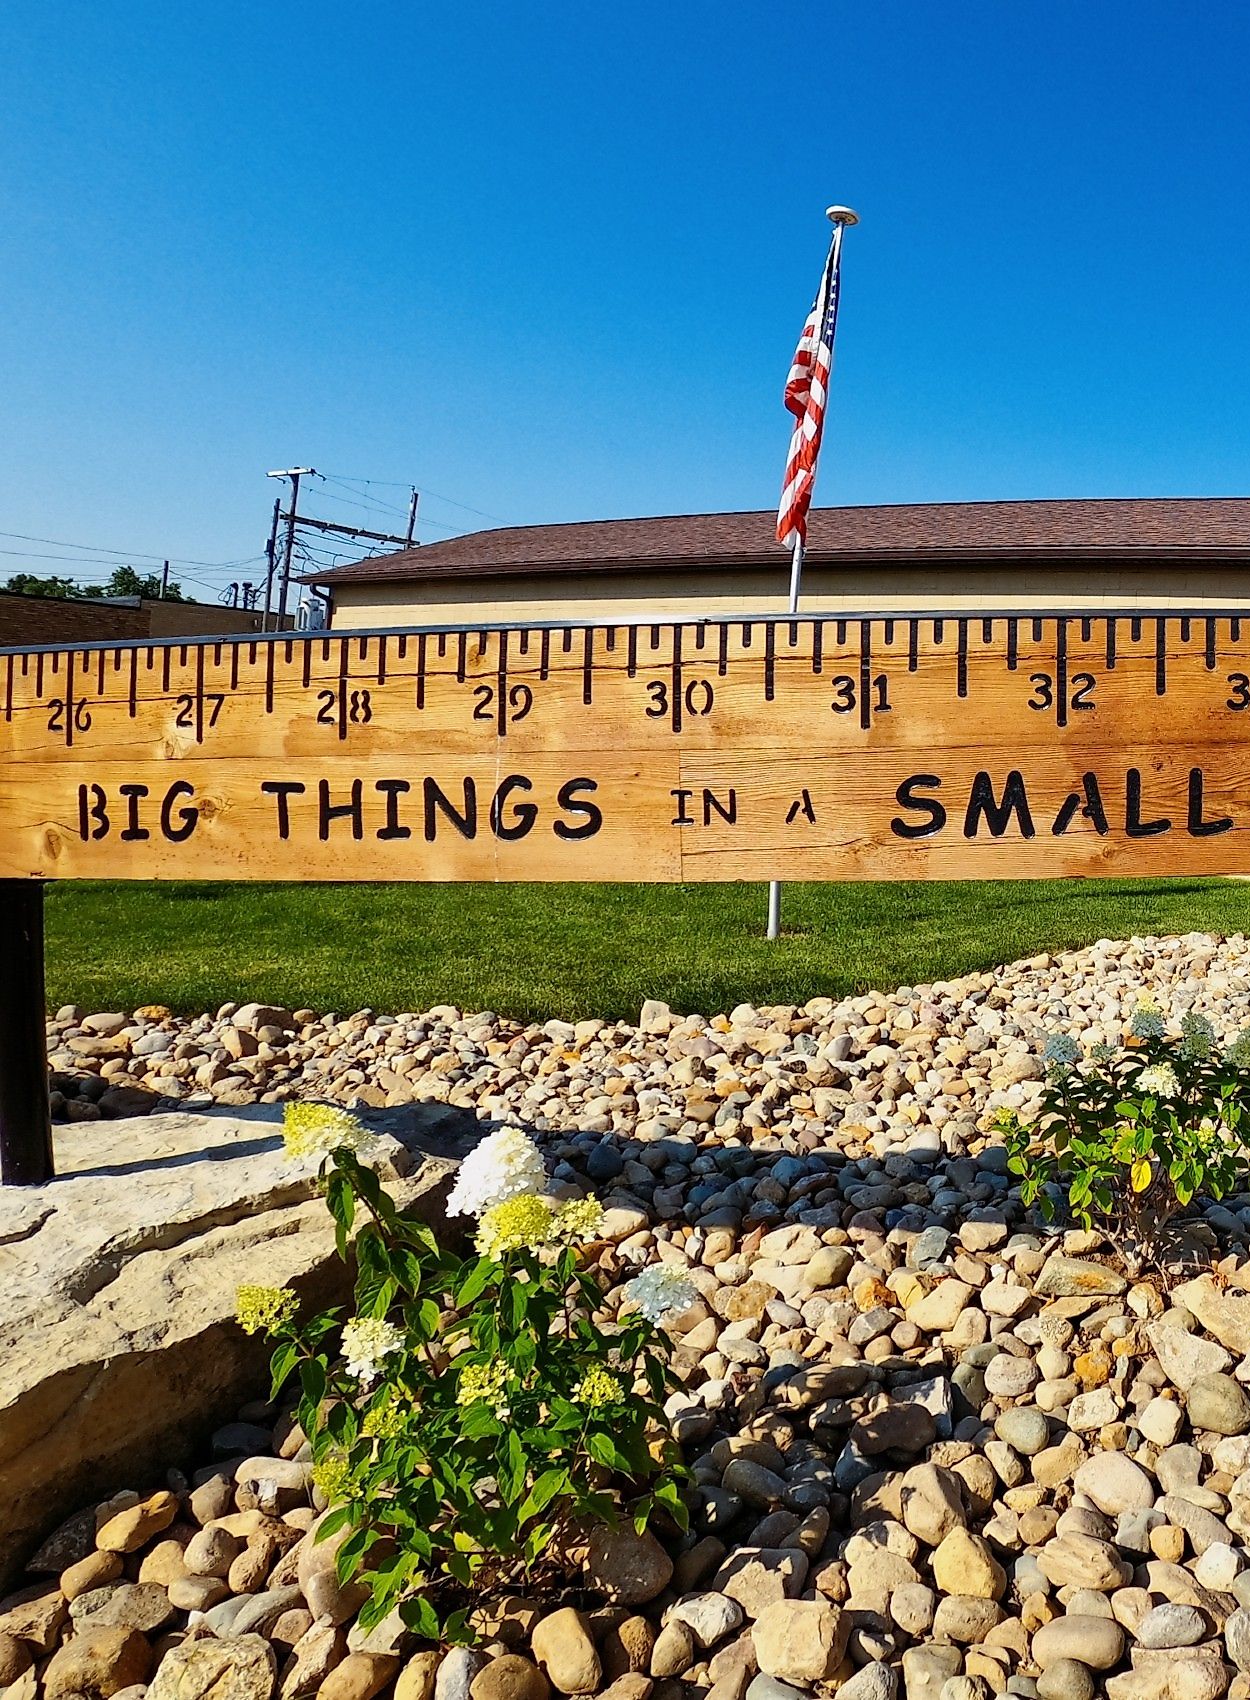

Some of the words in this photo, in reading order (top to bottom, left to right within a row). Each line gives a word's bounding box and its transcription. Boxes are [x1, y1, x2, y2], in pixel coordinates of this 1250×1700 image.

[46, 698, 92, 733] 26
[175, 693, 226, 728] 27
[316, 689, 373, 724] 28
[473, 685, 534, 722] 29
[645, 680, 714, 719] 30
[830, 674, 893, 714] 31
[1027, 672, 1097, 711] 32
[78, 781, 199, 842] BIG
[261, 774, 603, 841] THINGS
[670, 788, 737, 826] IN
[785, 788, 817, 825] A
[890, 768, 1234, 838] SMALL
